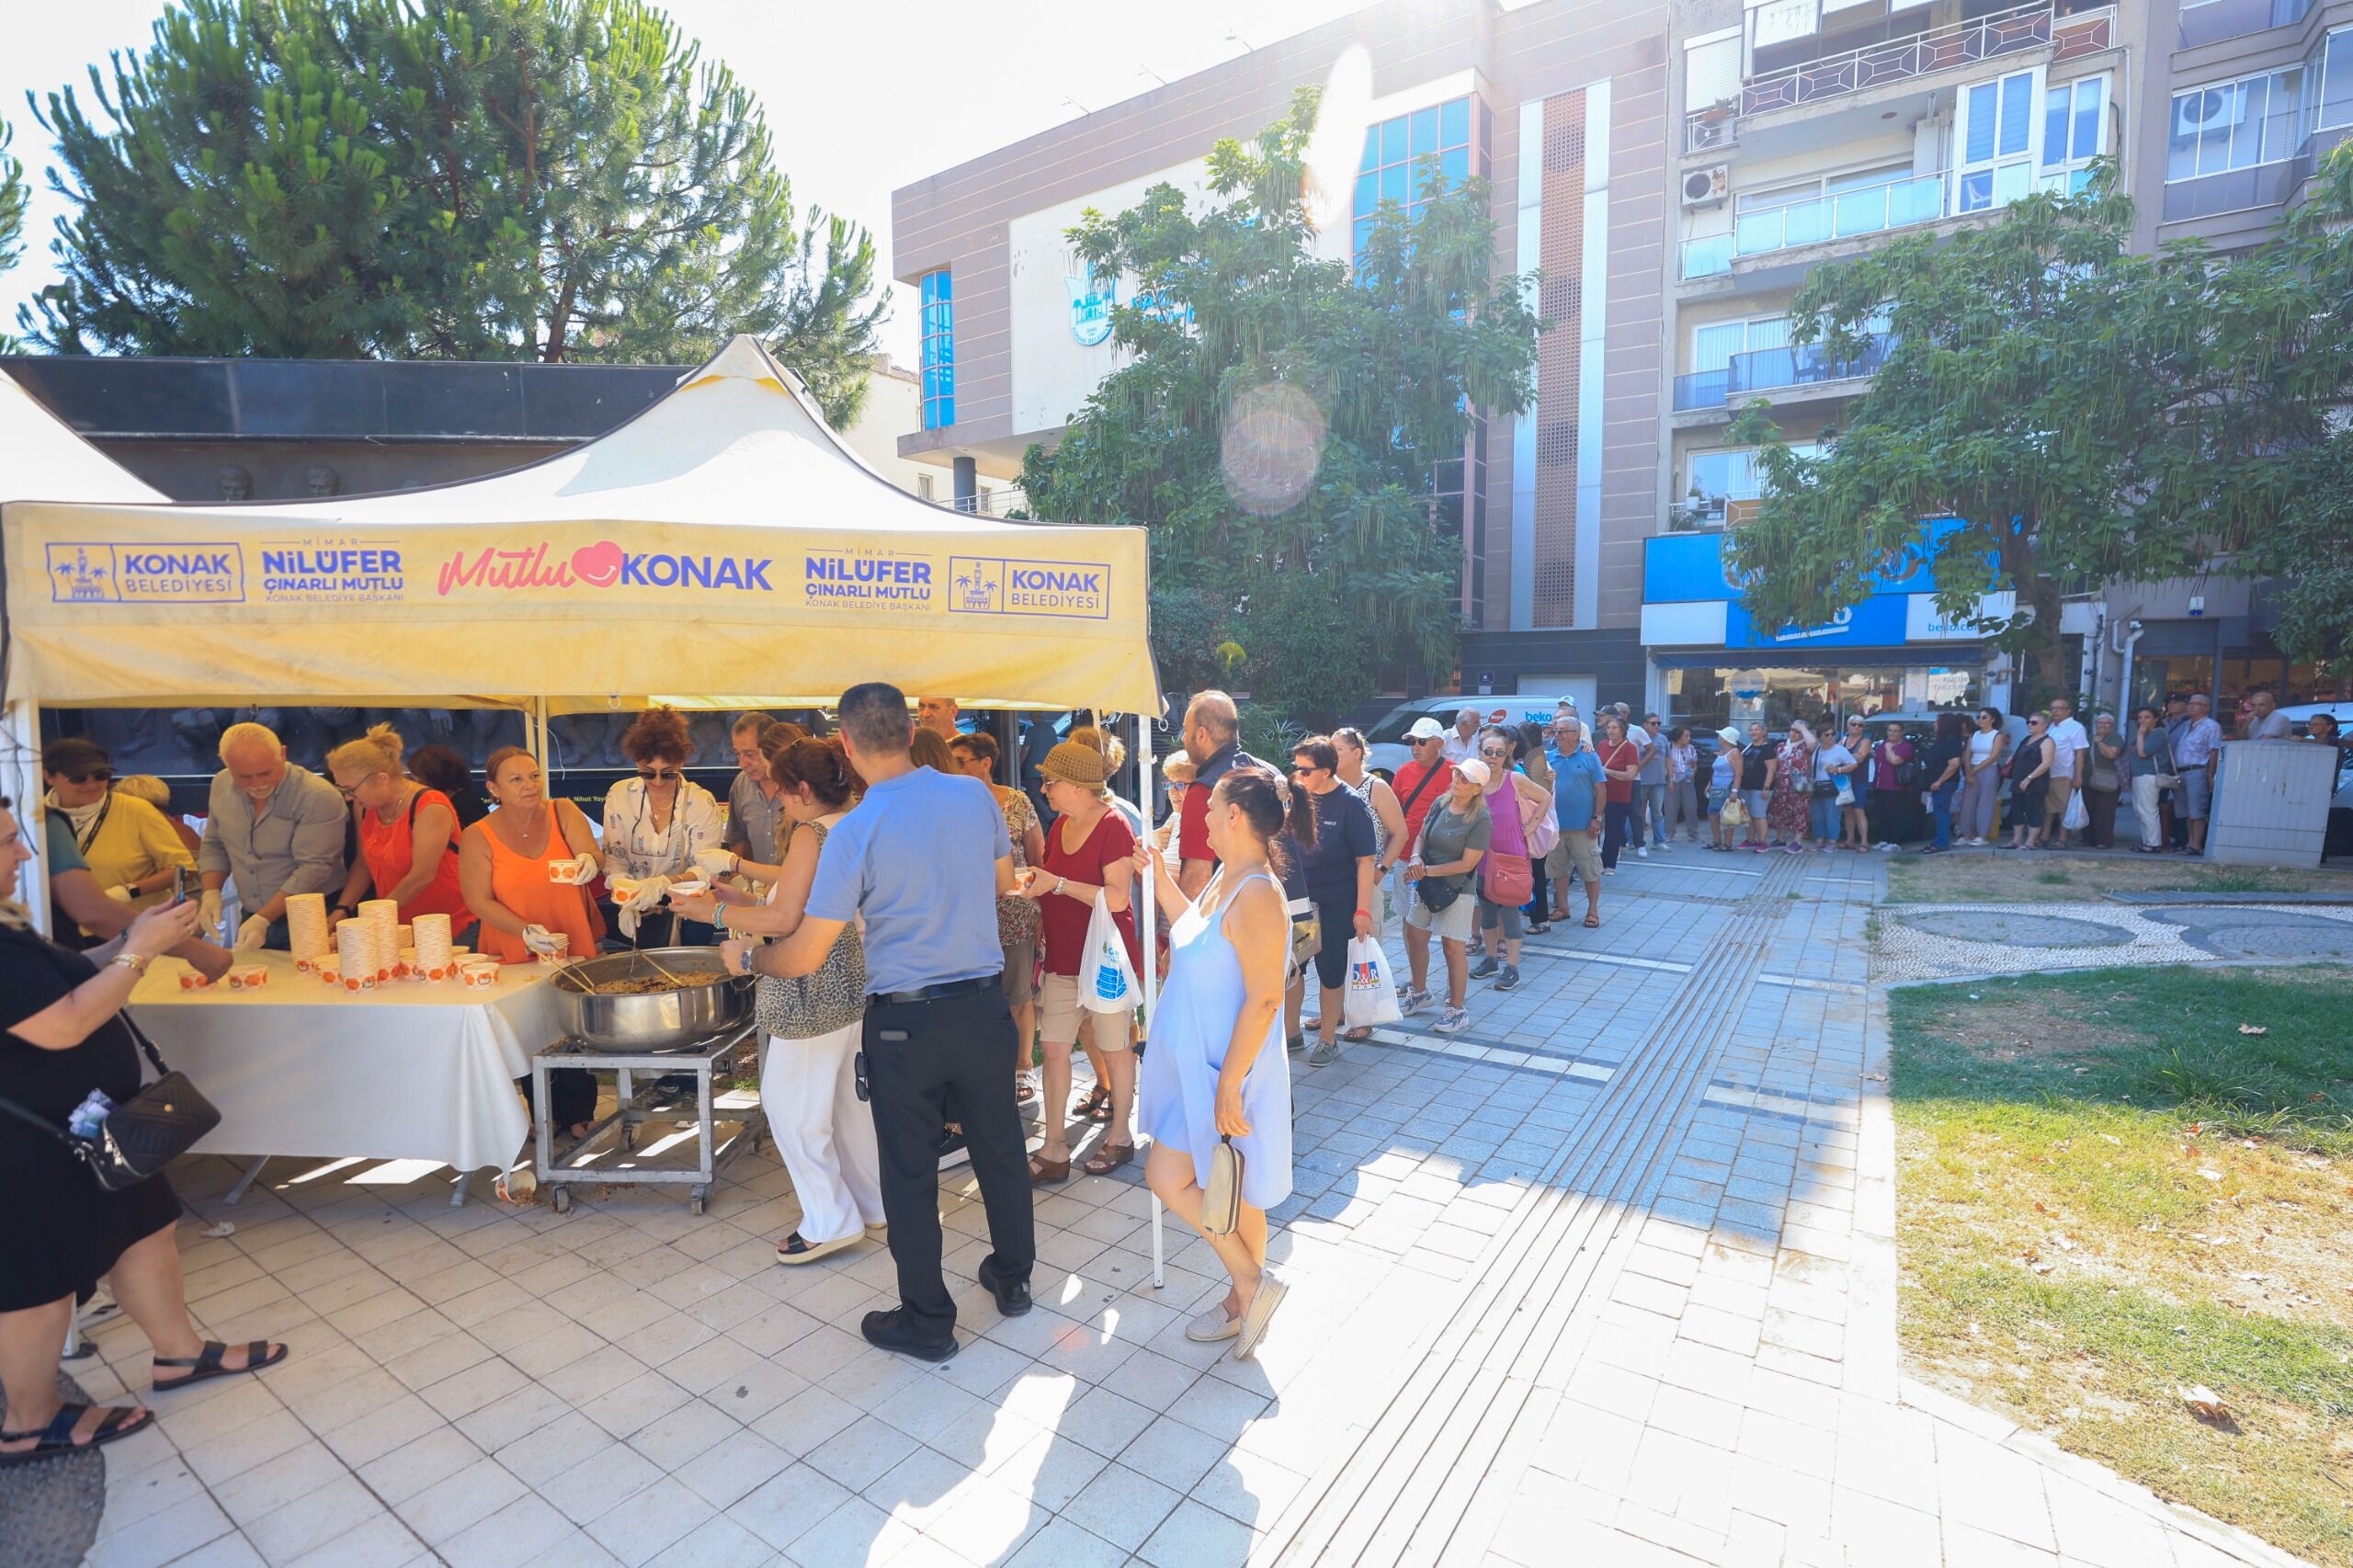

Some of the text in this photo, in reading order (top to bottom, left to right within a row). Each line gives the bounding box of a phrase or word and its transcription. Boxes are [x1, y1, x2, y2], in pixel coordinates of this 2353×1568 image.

[125, 553, 232, 574] KONAK
[438, 541, 774, 596] Mutlu KONAK
[125, 575, 233, 593] BELEDİYESİ
[264, 577, 404, 595] ÇINARLI MUTLU
[1012, 570, 1100, 593] KONAK
[266, 594, 404, 603] KONAK BELEDİYE BAŞKANI
[805, 583, 931, 600] ÇINARLI MUTLU
[1011, 592, 1099, 608] BELEDİYESİ
[805, 598, 931, 611] KONAK BELEDİYE BAŞKANI
[1526, 711, 1552, 722] beko
